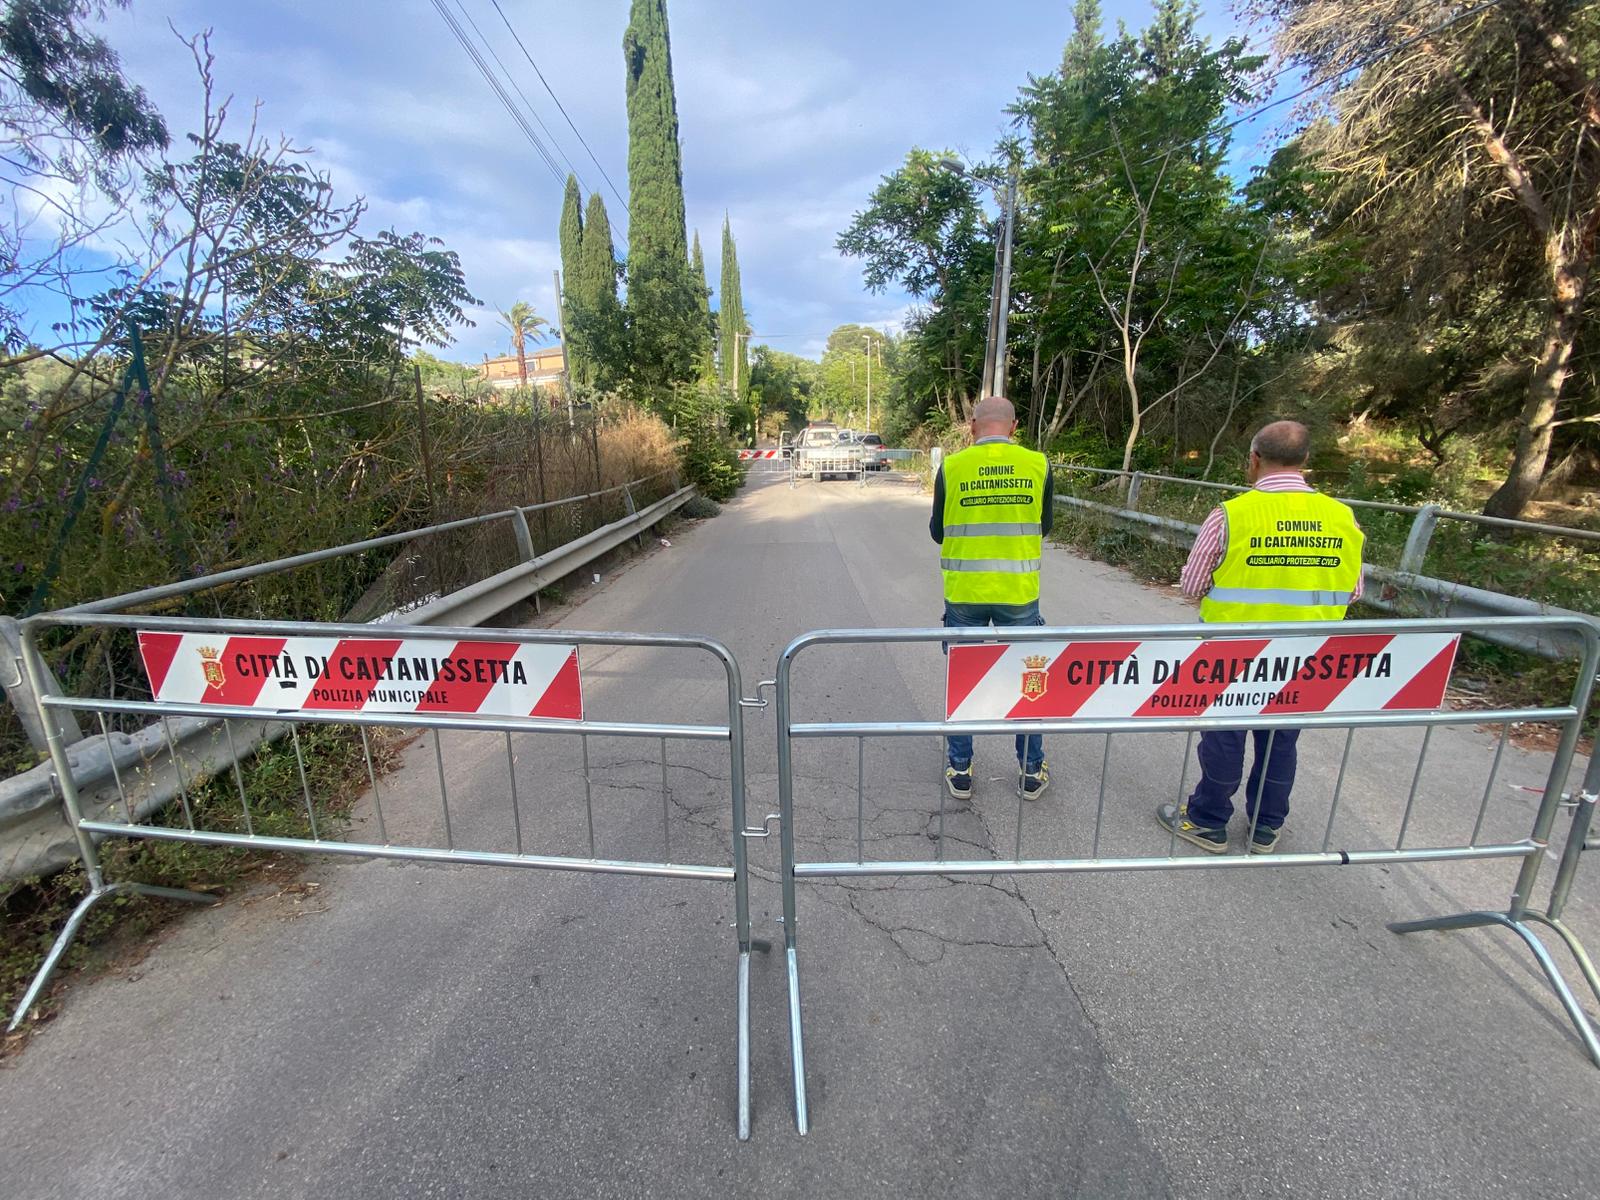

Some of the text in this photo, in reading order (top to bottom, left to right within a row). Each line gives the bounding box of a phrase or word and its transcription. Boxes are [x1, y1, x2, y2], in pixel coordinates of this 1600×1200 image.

[979, 466, 1014, 476] COMUNE
[960, 479, 1032, 491] DI CALTANISSETTA
[1277, 520, 1322, 532] COMUNE
[1250, 536, 1343, 549] DI CALTANISSETTA
[1249, 556, 1285, 565] AUSILIARIO
[236, 650, 527, 684] CITTÀ DI CALTANISSETTA
[1067, 652, 1393, 685] CITTÀ DI CALTANISSETTA
[313, 688, 449, 704] POLIZIA MUNICIPALE
[1151, 691, 1300, 708] POLIZIA MUNICIPALE
